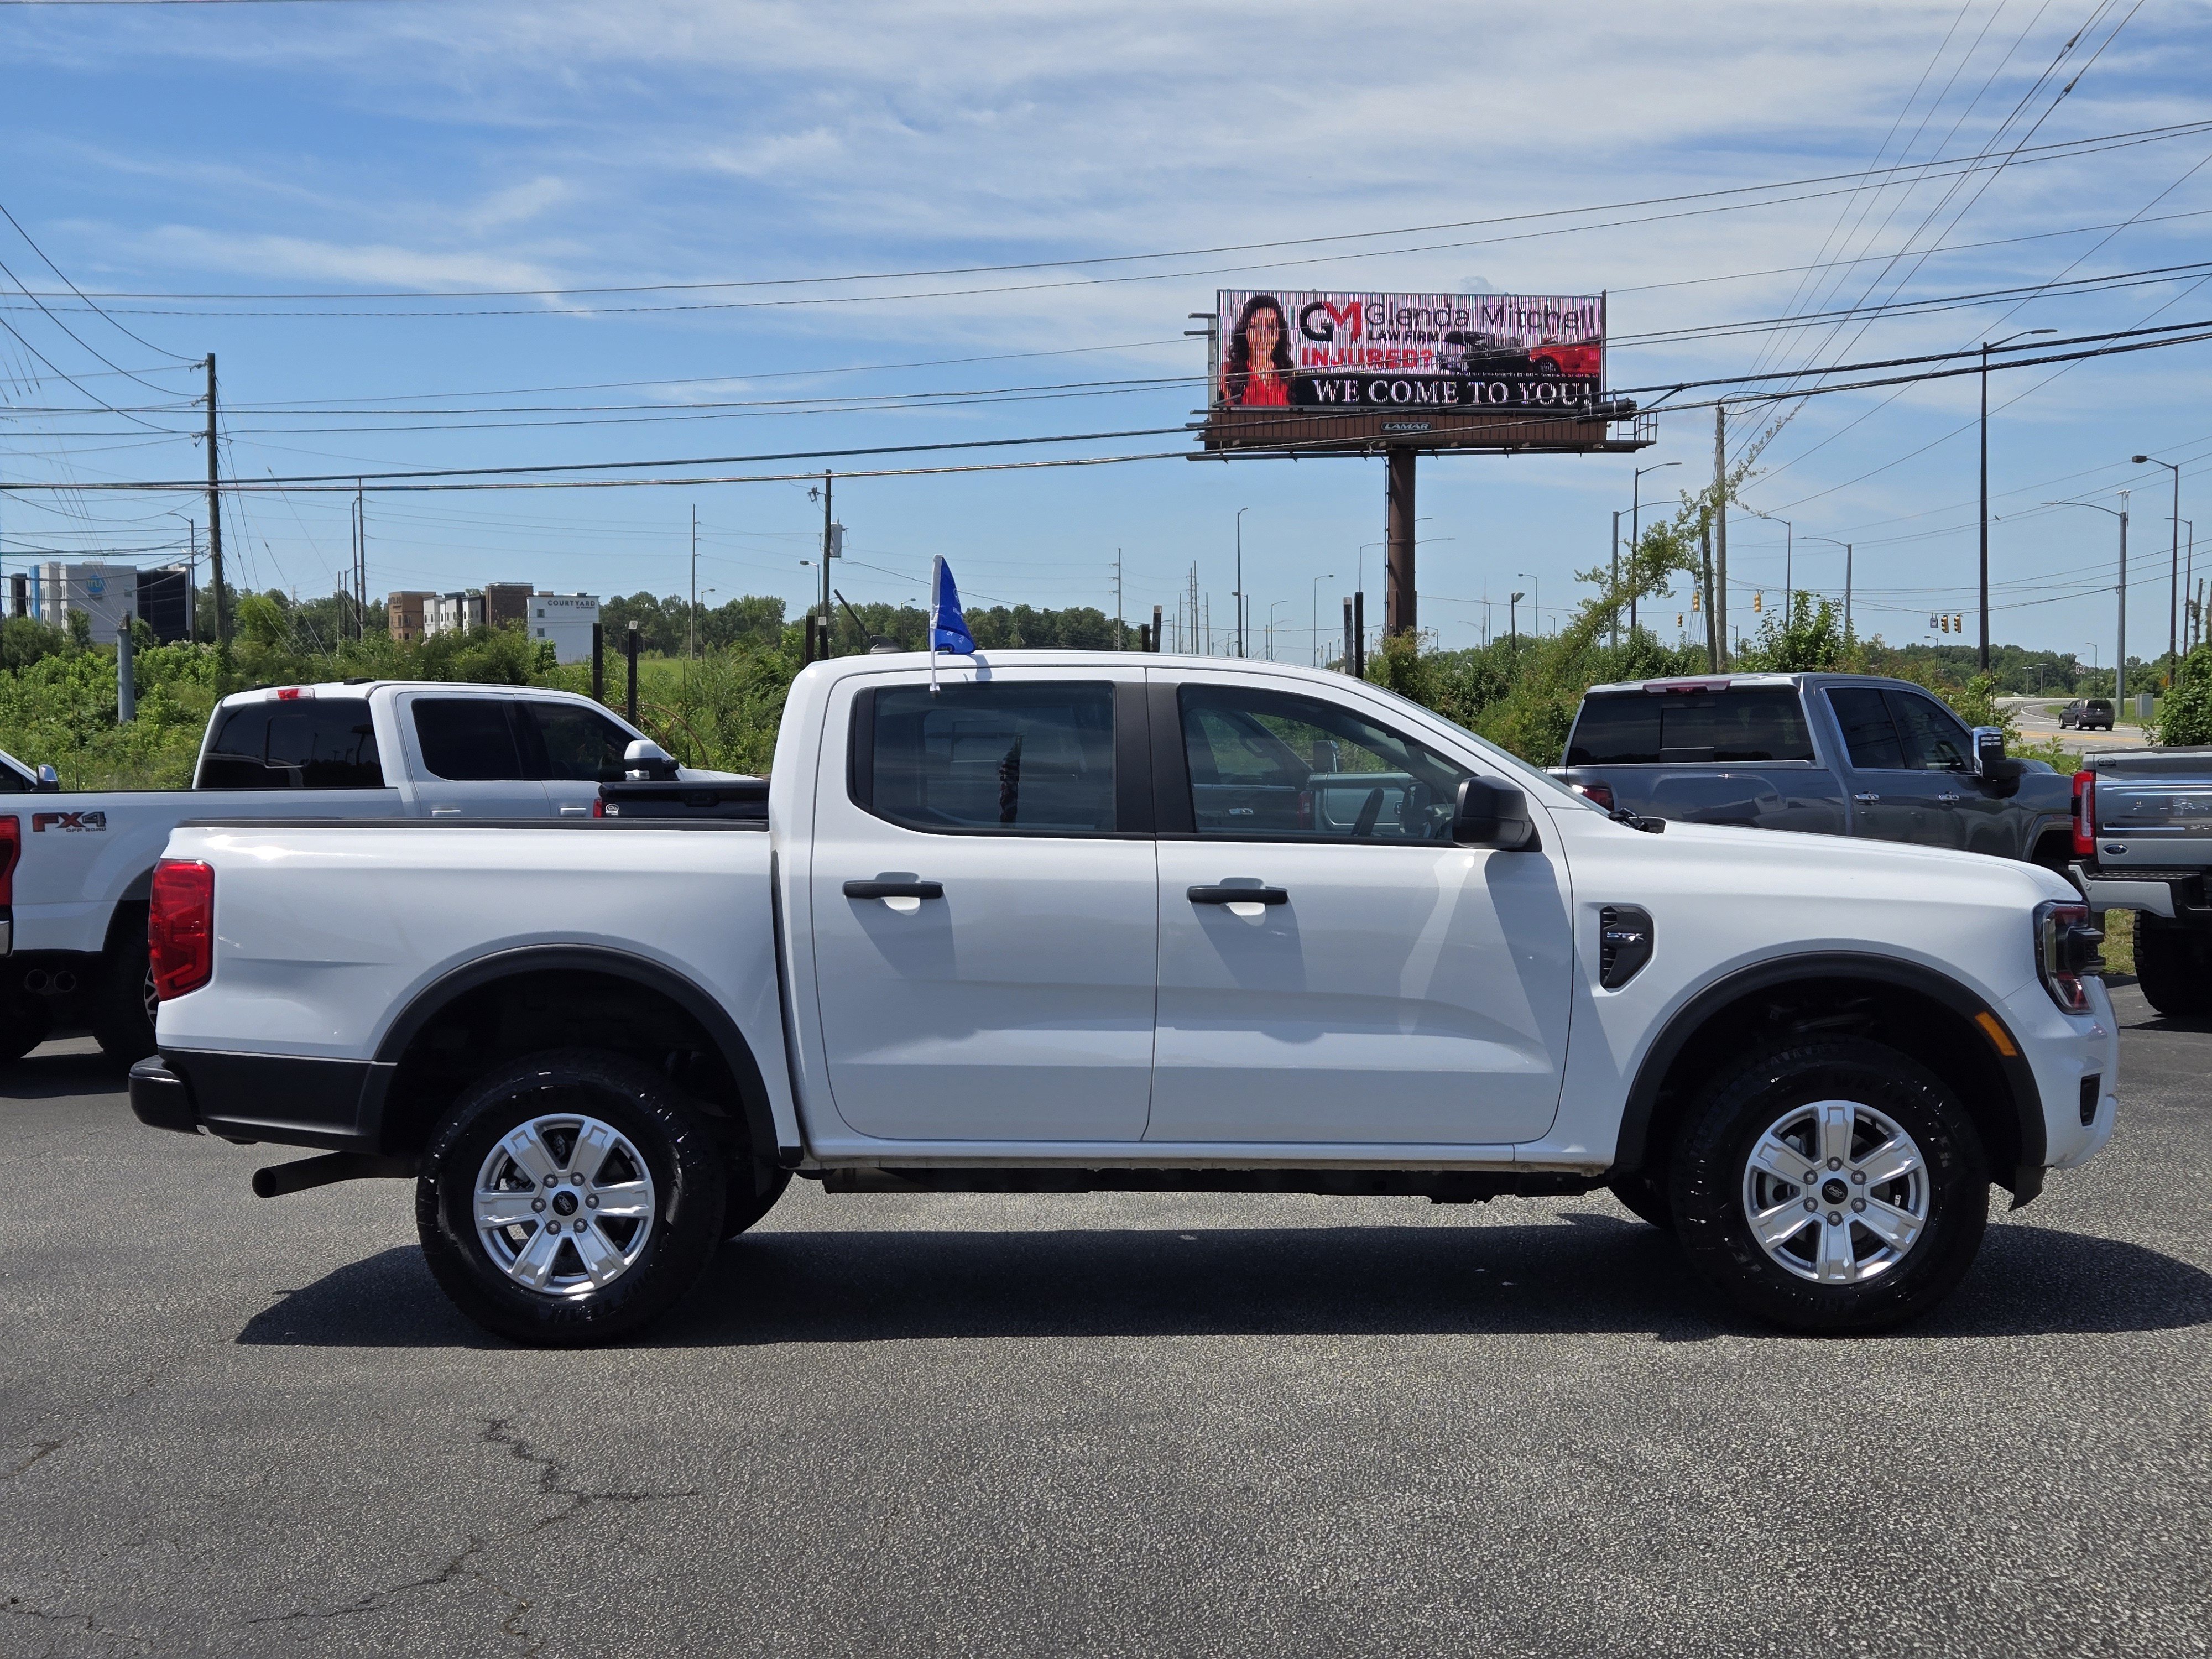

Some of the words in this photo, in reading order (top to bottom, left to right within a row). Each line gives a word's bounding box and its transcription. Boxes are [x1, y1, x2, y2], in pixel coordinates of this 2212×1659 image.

[1300, 301, 1362, 342] GM
[1365, 302, 1469, 327] Glenda
[1483, 304, 1594, 330] Mitchell
[1368, 331, 1400, 341] LAW
[1404, 331, 1439, 342] FIRM
[1301, 347, 1434, 369] INJURED?
[1312, 380, 1360, 401] WE
[1369, 380, 1459, 404] COME
[1467, 382, 1509, 404] TO
[1517, 382, 1590, 405] YOU!
[32, 811, 106, 832] FX4
[1607, 932, 1644, 941] STX
